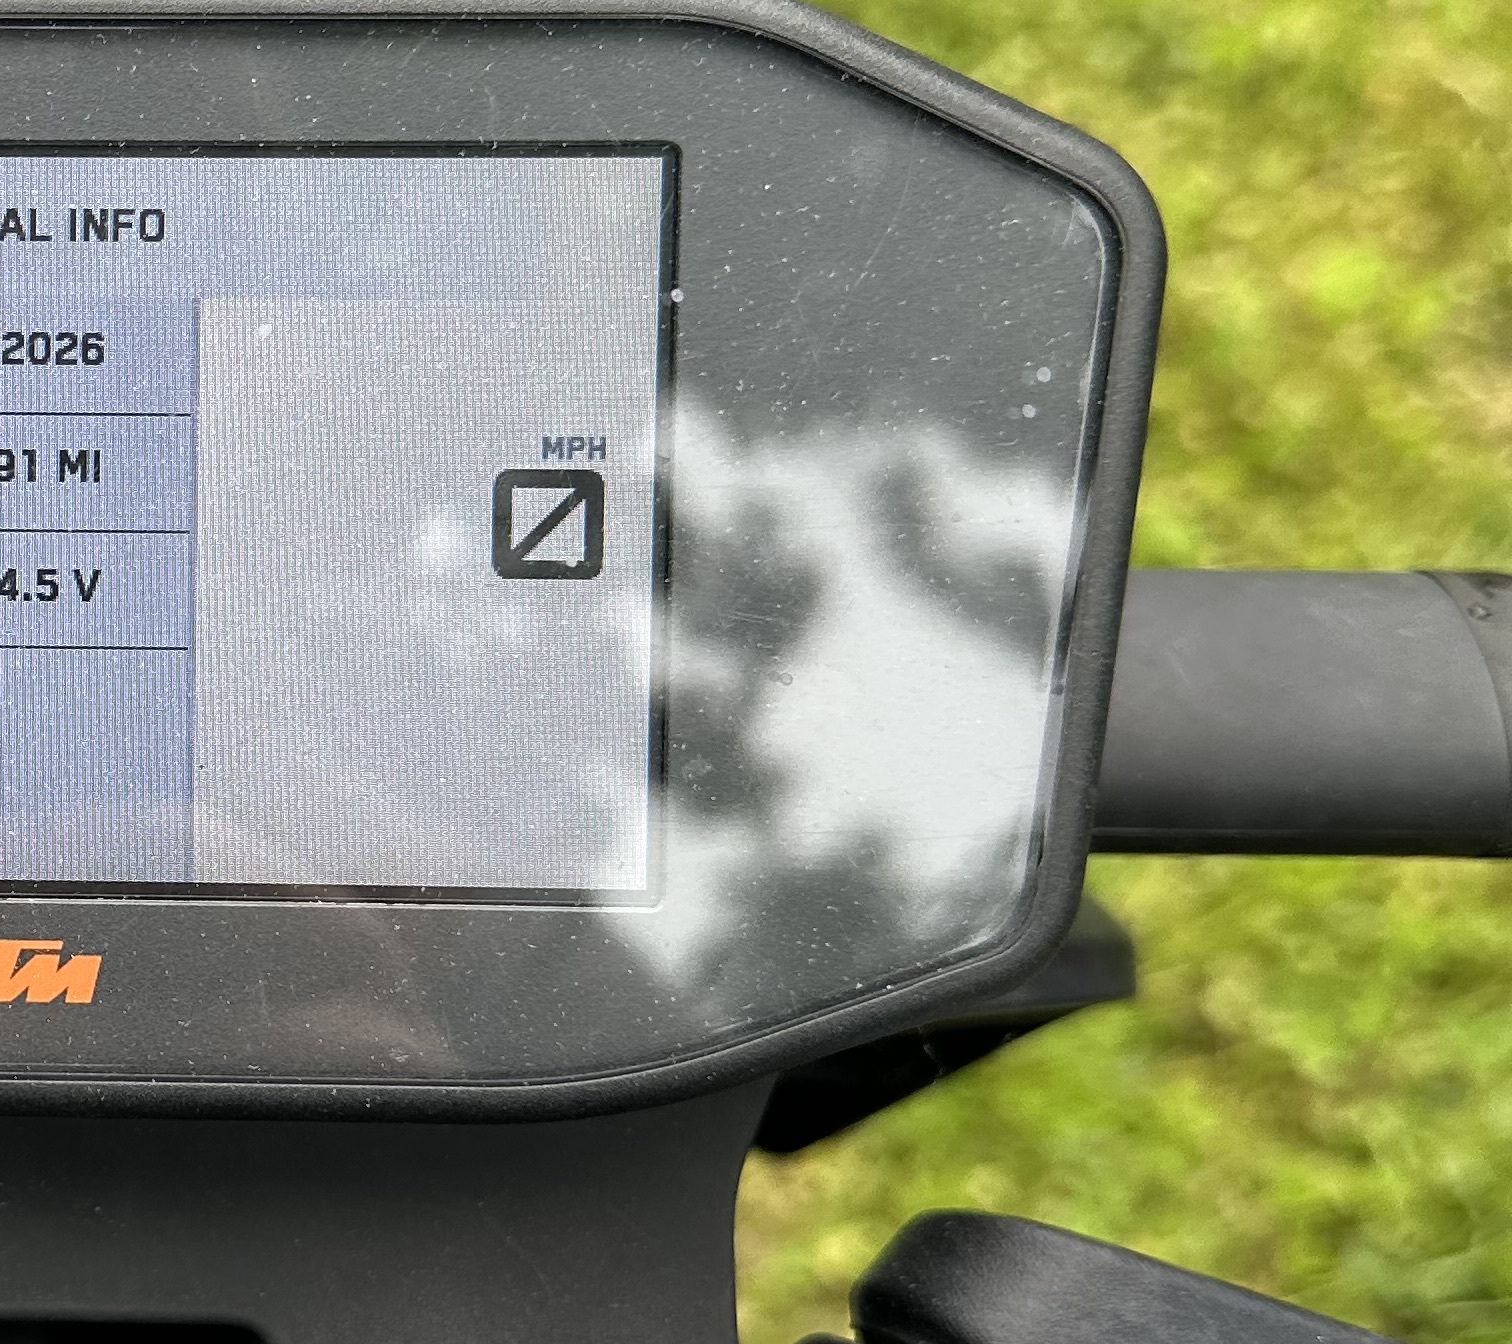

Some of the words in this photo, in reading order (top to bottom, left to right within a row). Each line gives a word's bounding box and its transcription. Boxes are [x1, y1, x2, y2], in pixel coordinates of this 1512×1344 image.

[68, 208, 166, 243] INFO
[541, 435, 607, 461] MPH
[58, 449, 102, 484] MI
[71, 568, 102, 603] V
